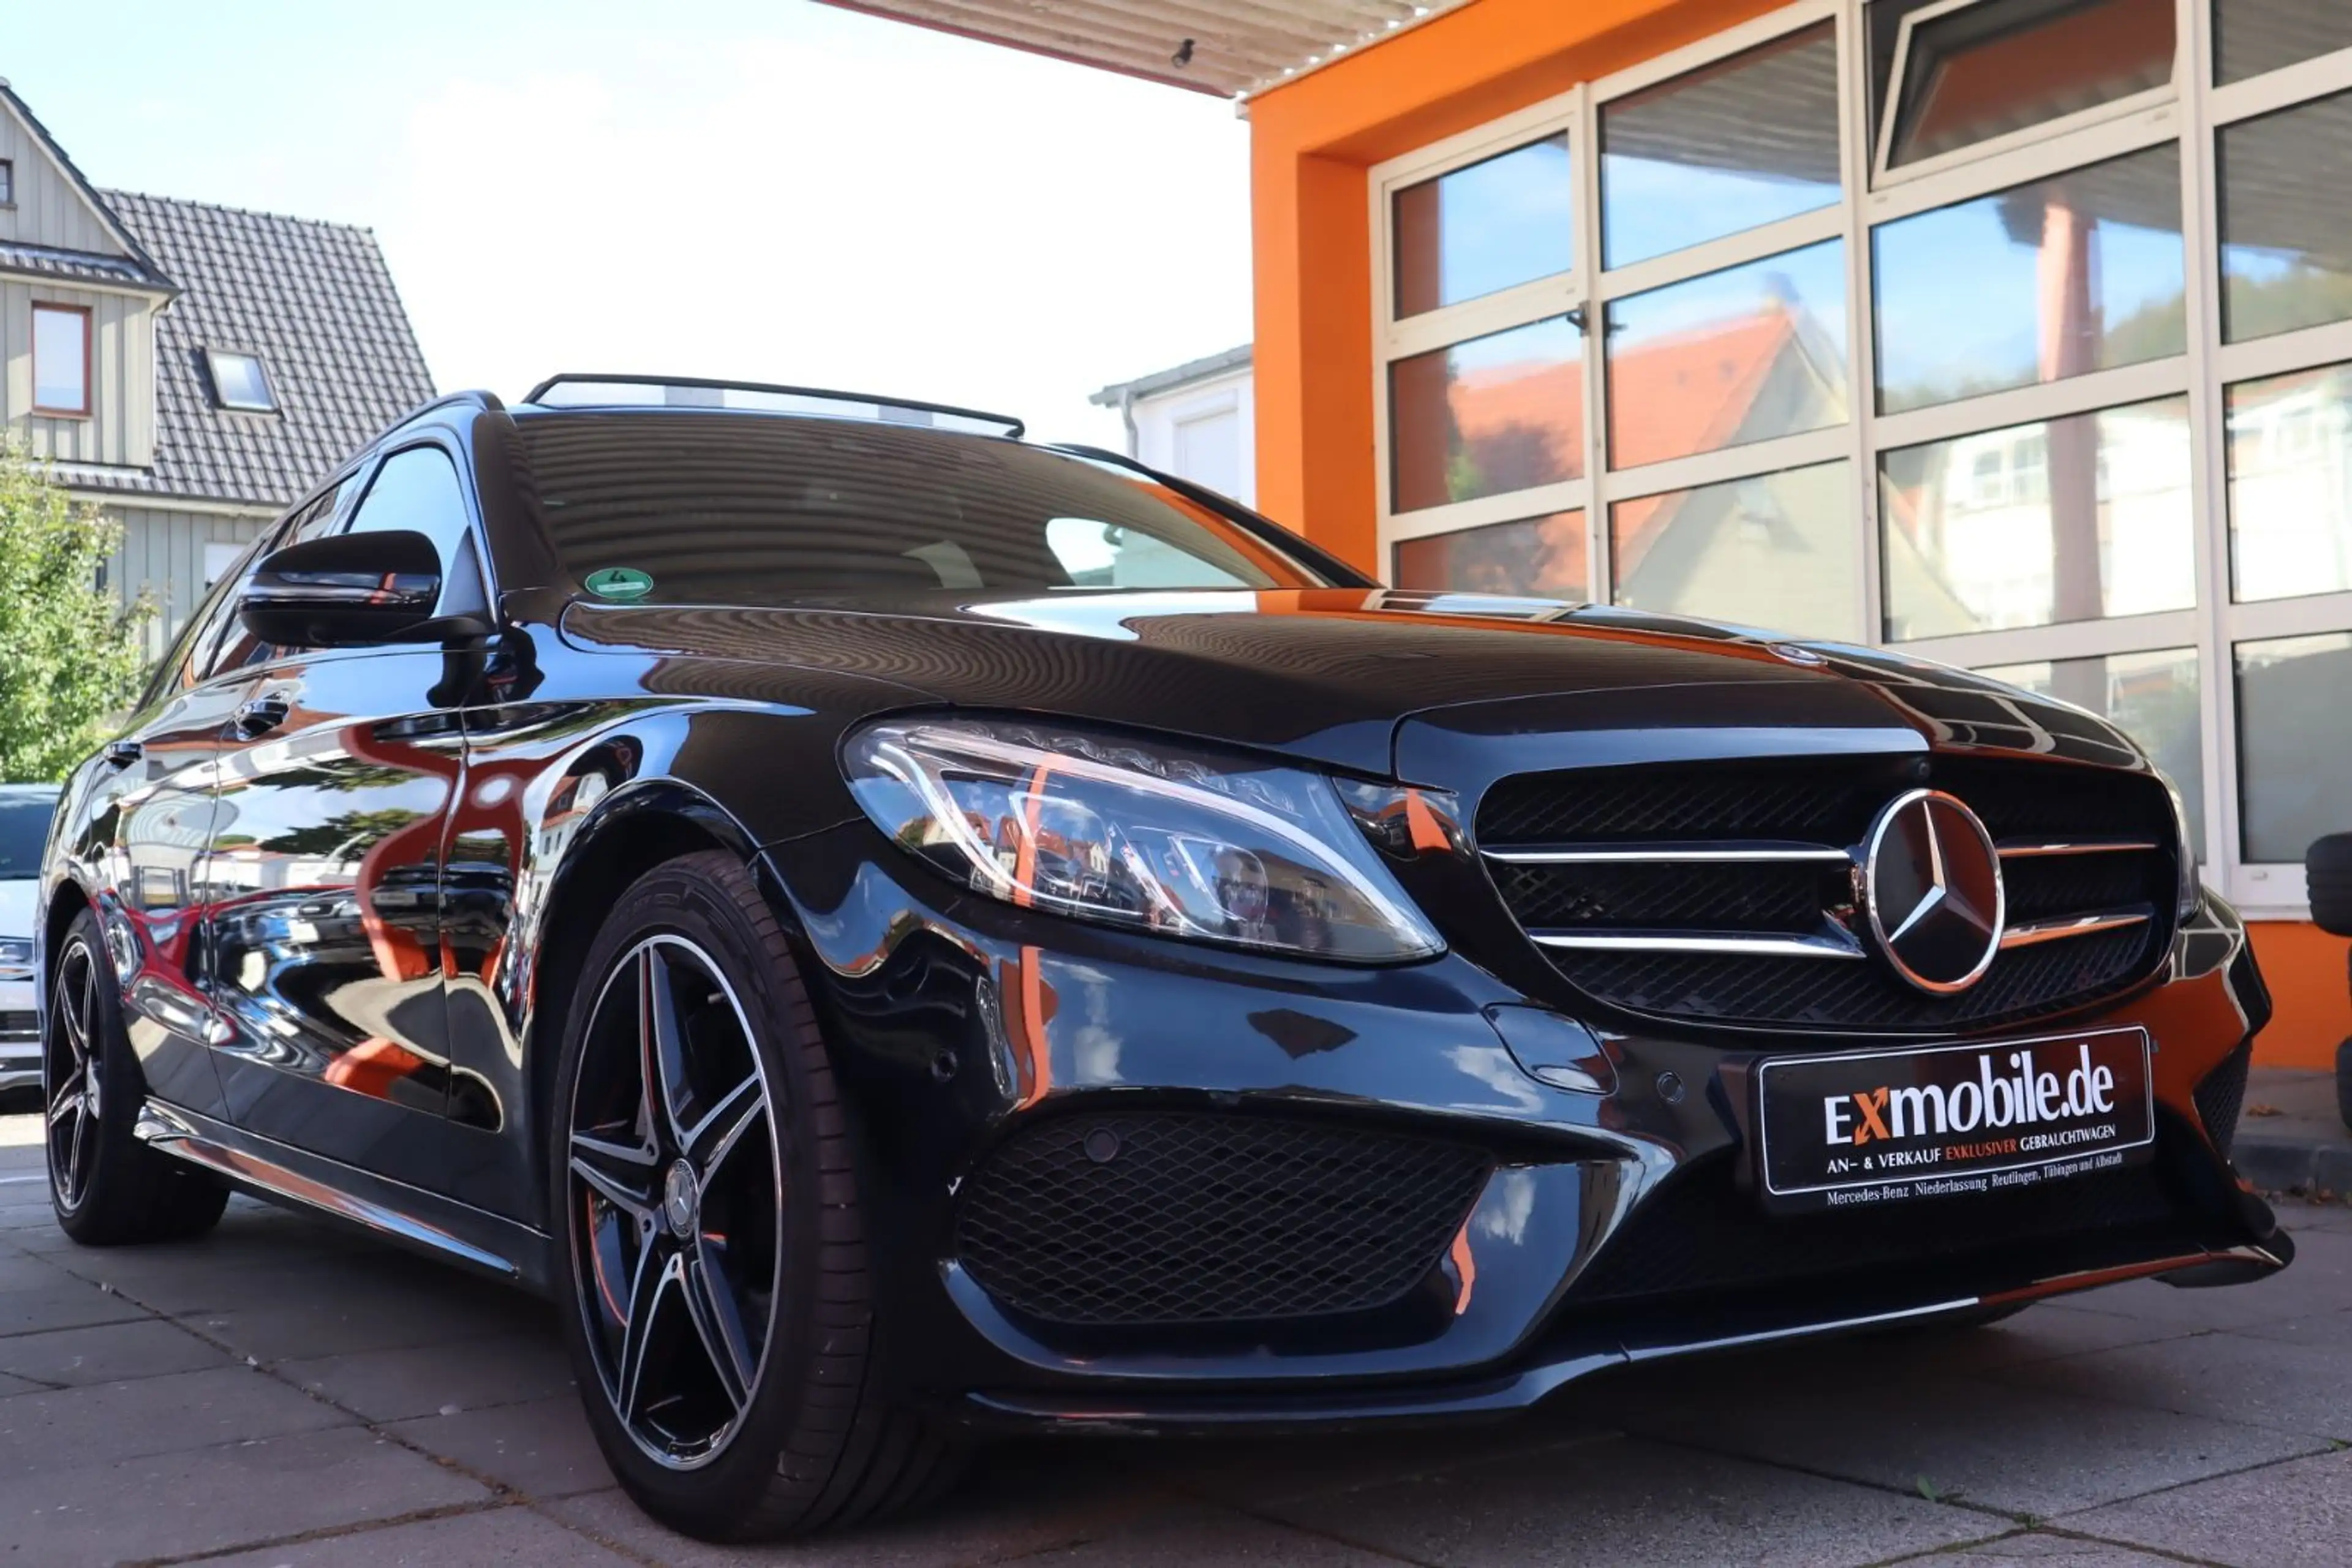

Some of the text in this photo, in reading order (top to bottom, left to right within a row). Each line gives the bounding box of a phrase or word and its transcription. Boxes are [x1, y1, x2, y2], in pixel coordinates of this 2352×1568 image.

[1864, 1156, 1872, 1169] &
[1878, 1147, 1941, 1167] VERKAUF
[1945, 1138, 2017, 1161] EXKLUSIVER
[2020, 1123, 2116, 1151] GEBRAUCHTWAGEN
[1827, 1152, 2122, 1205] Mercedes-Benz Niederlassung Reutlingen, Tübingen und Albstadt
